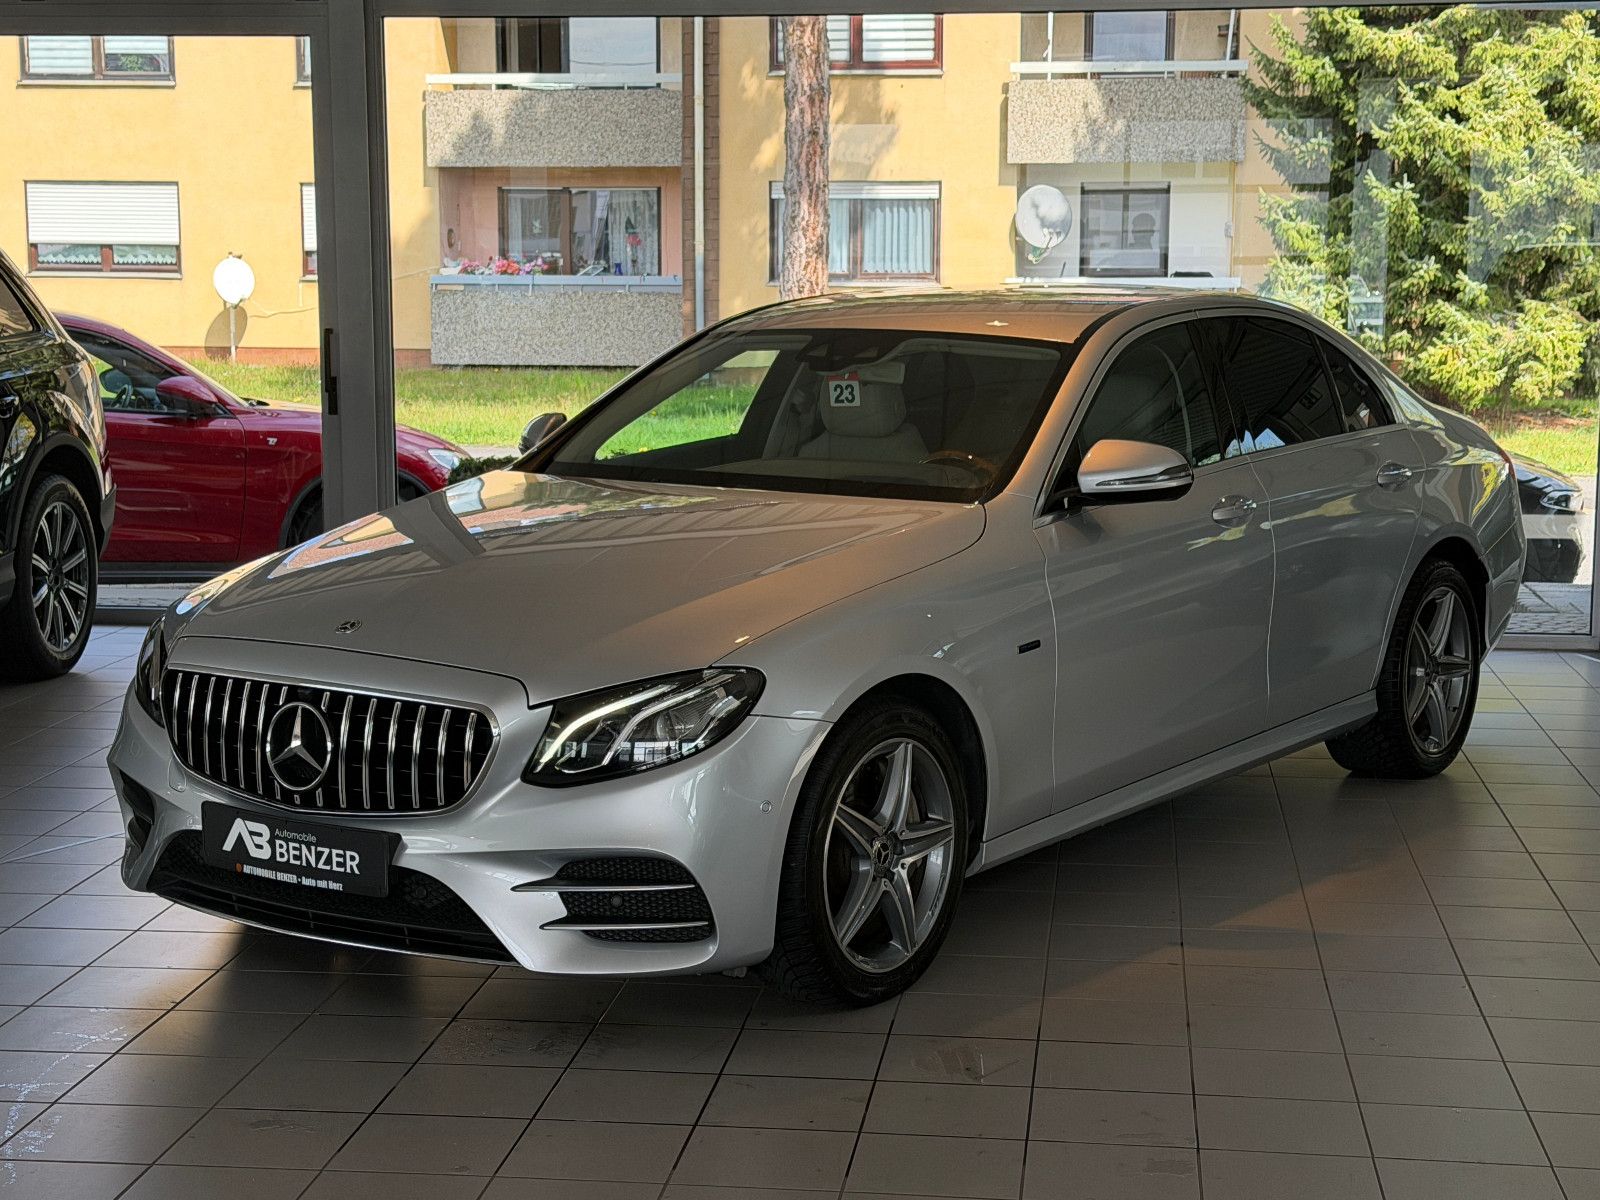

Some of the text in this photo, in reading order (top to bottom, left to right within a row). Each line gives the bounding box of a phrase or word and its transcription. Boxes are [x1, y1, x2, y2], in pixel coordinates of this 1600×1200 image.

[833, 383, 856, 404] 23
[222, 817, 272, 860] AB
[274, 828, 317, 844] Automobile
[274, 839, 361, 875] BENZER
[242, 863, 344, 892] AUTOMOBILE BENZER Auto mit Herz
